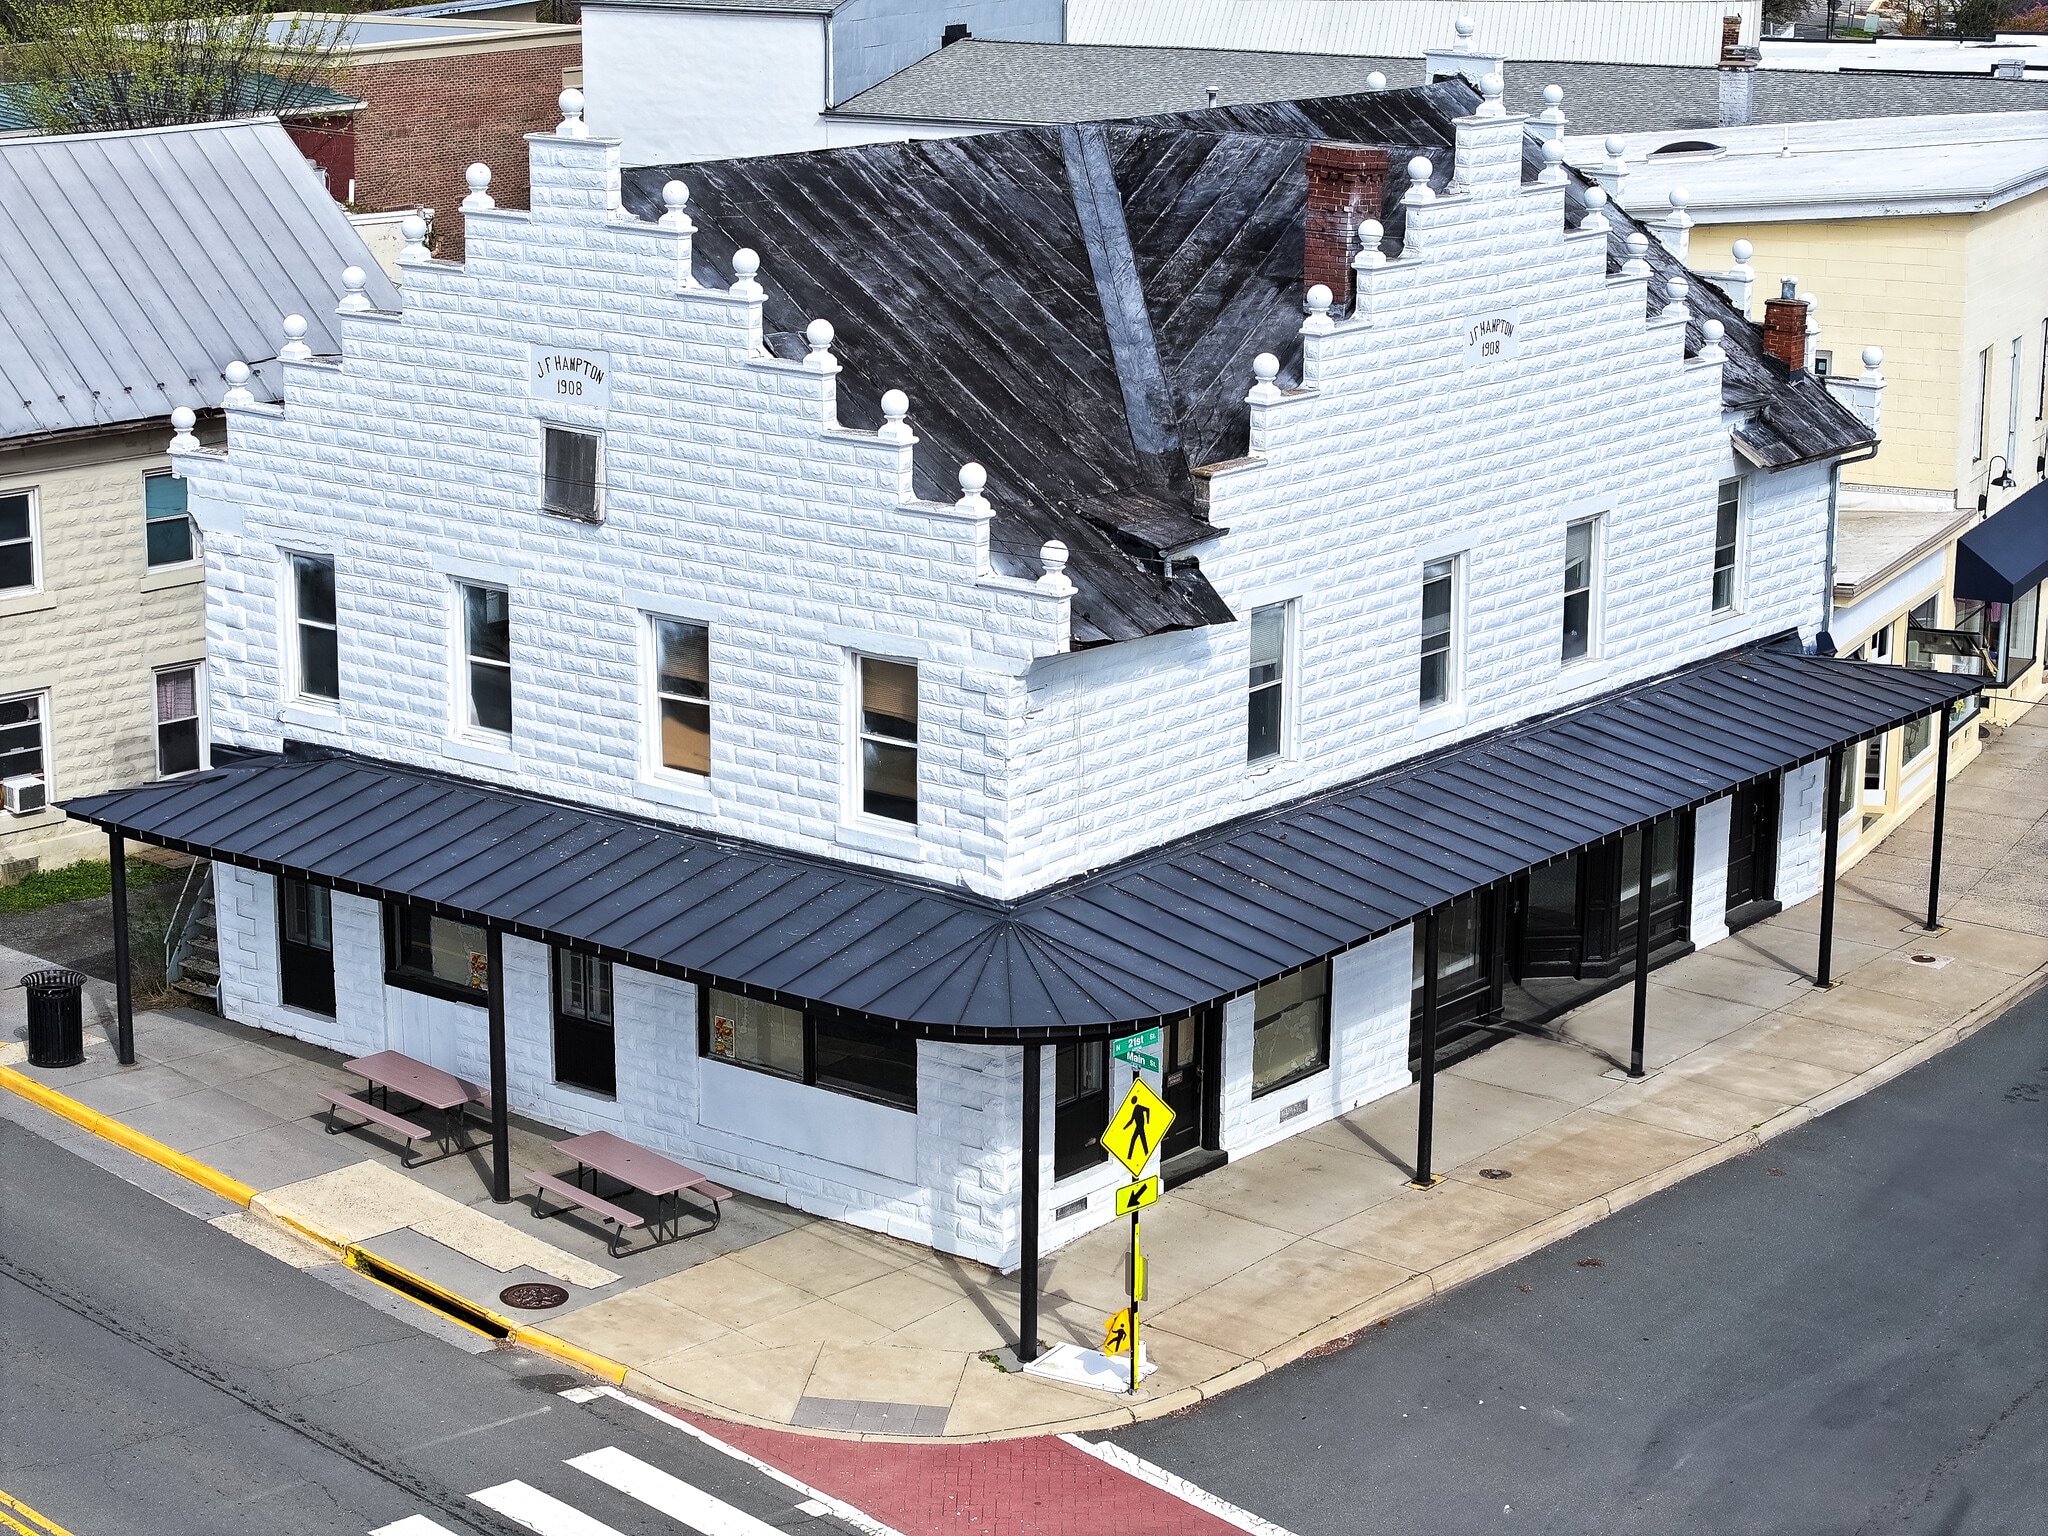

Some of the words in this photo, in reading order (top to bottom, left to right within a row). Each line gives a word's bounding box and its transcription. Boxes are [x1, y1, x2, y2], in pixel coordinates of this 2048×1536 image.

[1479, 318, 1515, 338] HAMPTON
[1481, 340, 1501, 358] 1908
[554, 354, 605, 385] HAMPTON
[557, 379, 583, 396] 1908
[1115, 1044, 1121, 1052] N
[1127, 1034, 1144, 1049] 21st
[1126, 1051, 1146, 1065] Main
